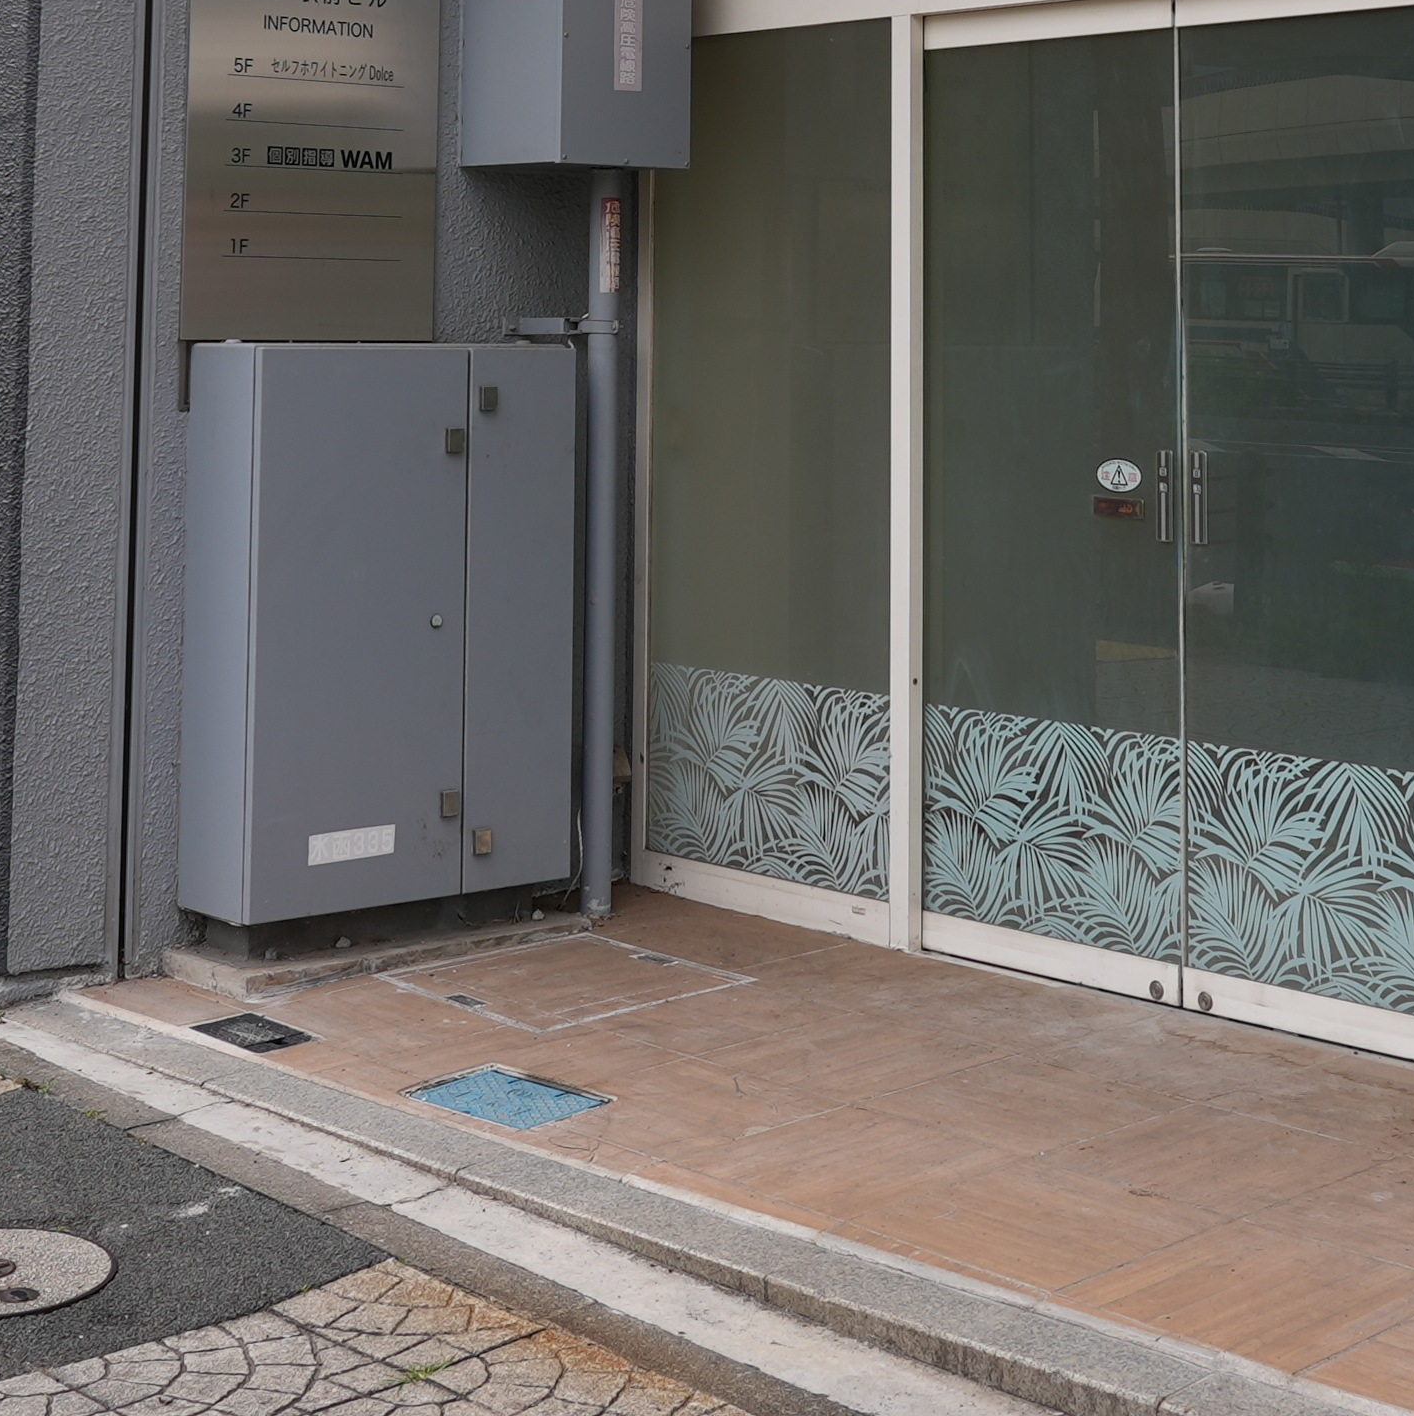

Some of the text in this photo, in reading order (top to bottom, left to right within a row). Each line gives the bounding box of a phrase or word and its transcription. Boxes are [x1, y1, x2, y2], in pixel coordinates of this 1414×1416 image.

[263, 14, 374, 39] INFORMATION
[234, 57, 254, 73] 5F
[232, 102, 253, 118] 4F
[231, 145, 393, 170] 3F 個別指導 WAM
[230, 192, 251, 209] 2F
[230, 238, 250, 254] 1F
